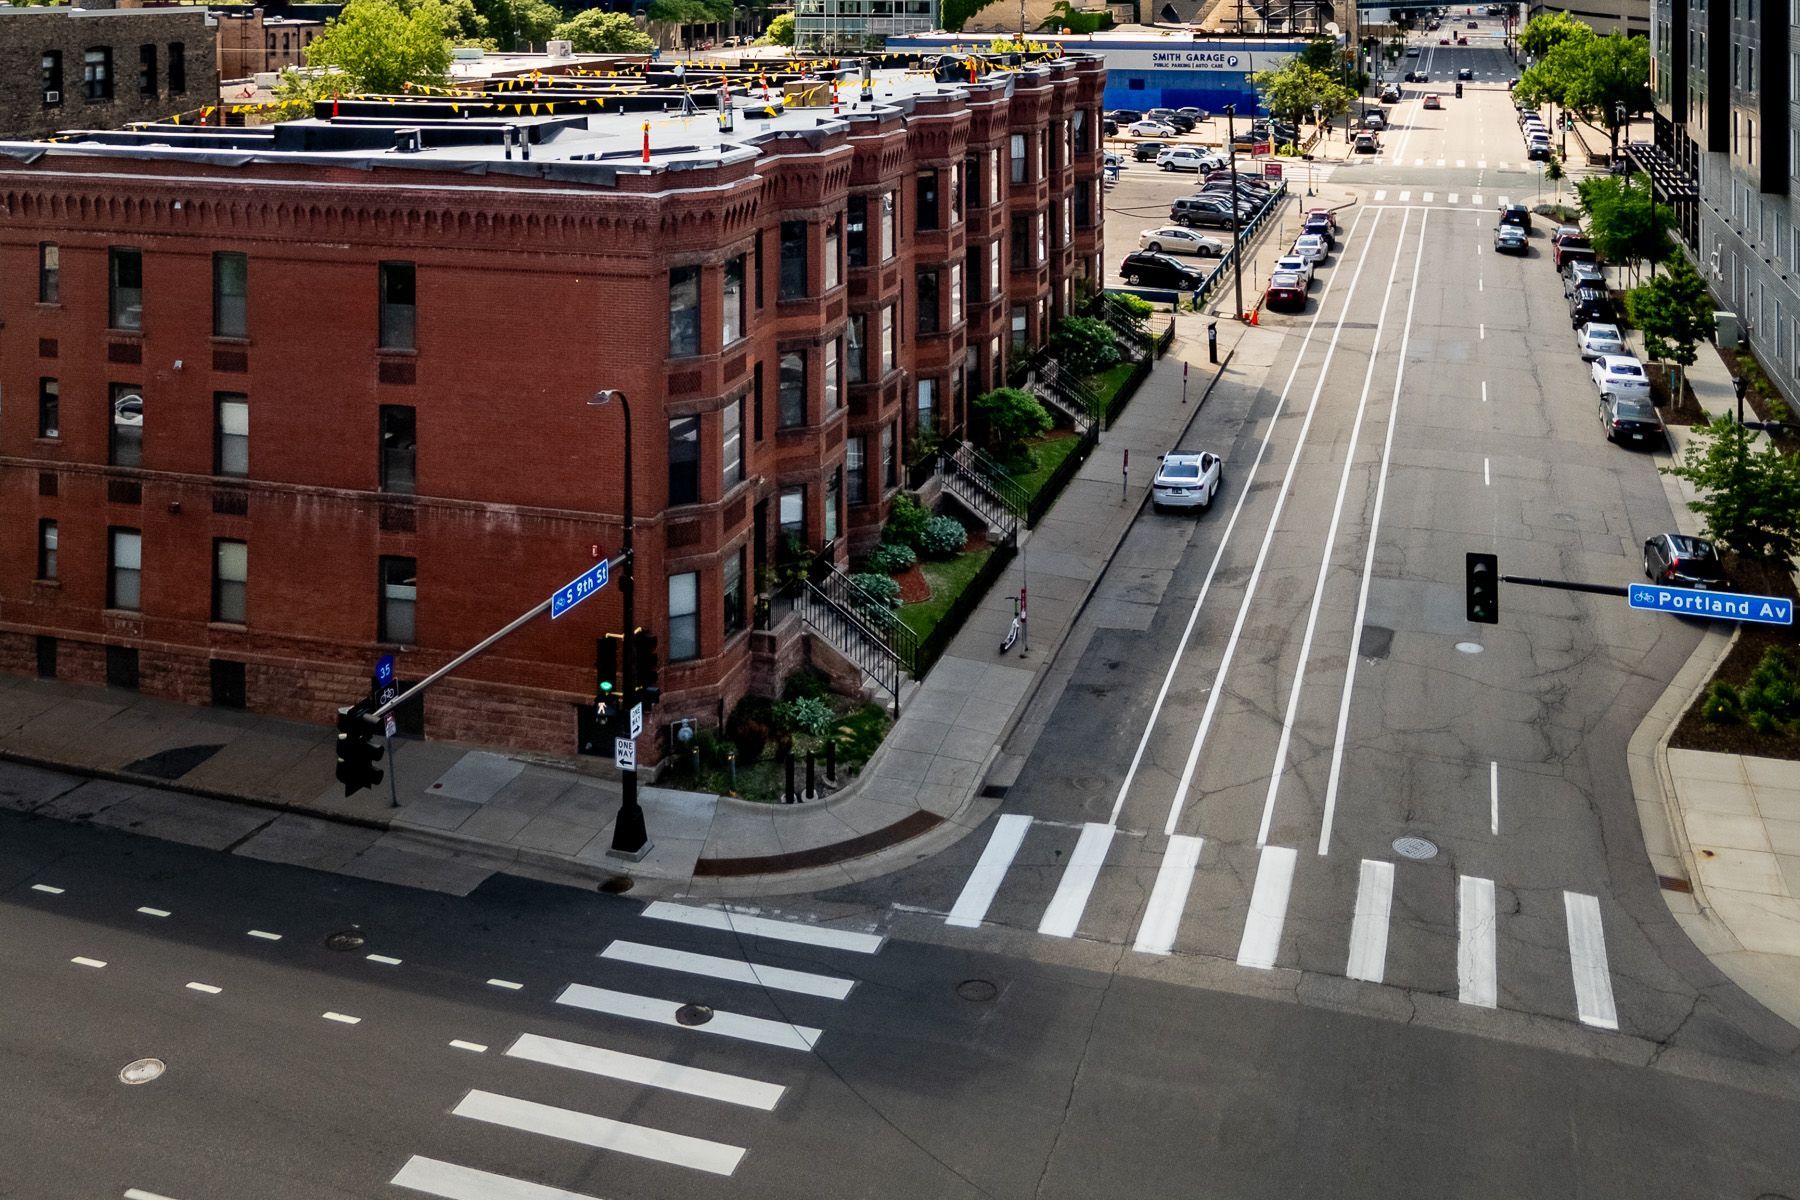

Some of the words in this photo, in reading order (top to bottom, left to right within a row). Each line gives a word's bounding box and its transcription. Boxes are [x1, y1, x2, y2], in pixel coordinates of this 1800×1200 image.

[1152, 52, 1181, 61] SMITH
[1186, 53, 1225, 62] GARAGE
[567, 588, 573, 604] S
[576, 577, 594, 597] 9th
[597, 567, 606, 583] St
[1658, 591, 1749, 615] Portland
[1759, 602, 1786, 619] Av
[380, 663, 390, 678] 35
[618, 740, 633, 750] ONE
[618, 749, 634, 759] WAY
